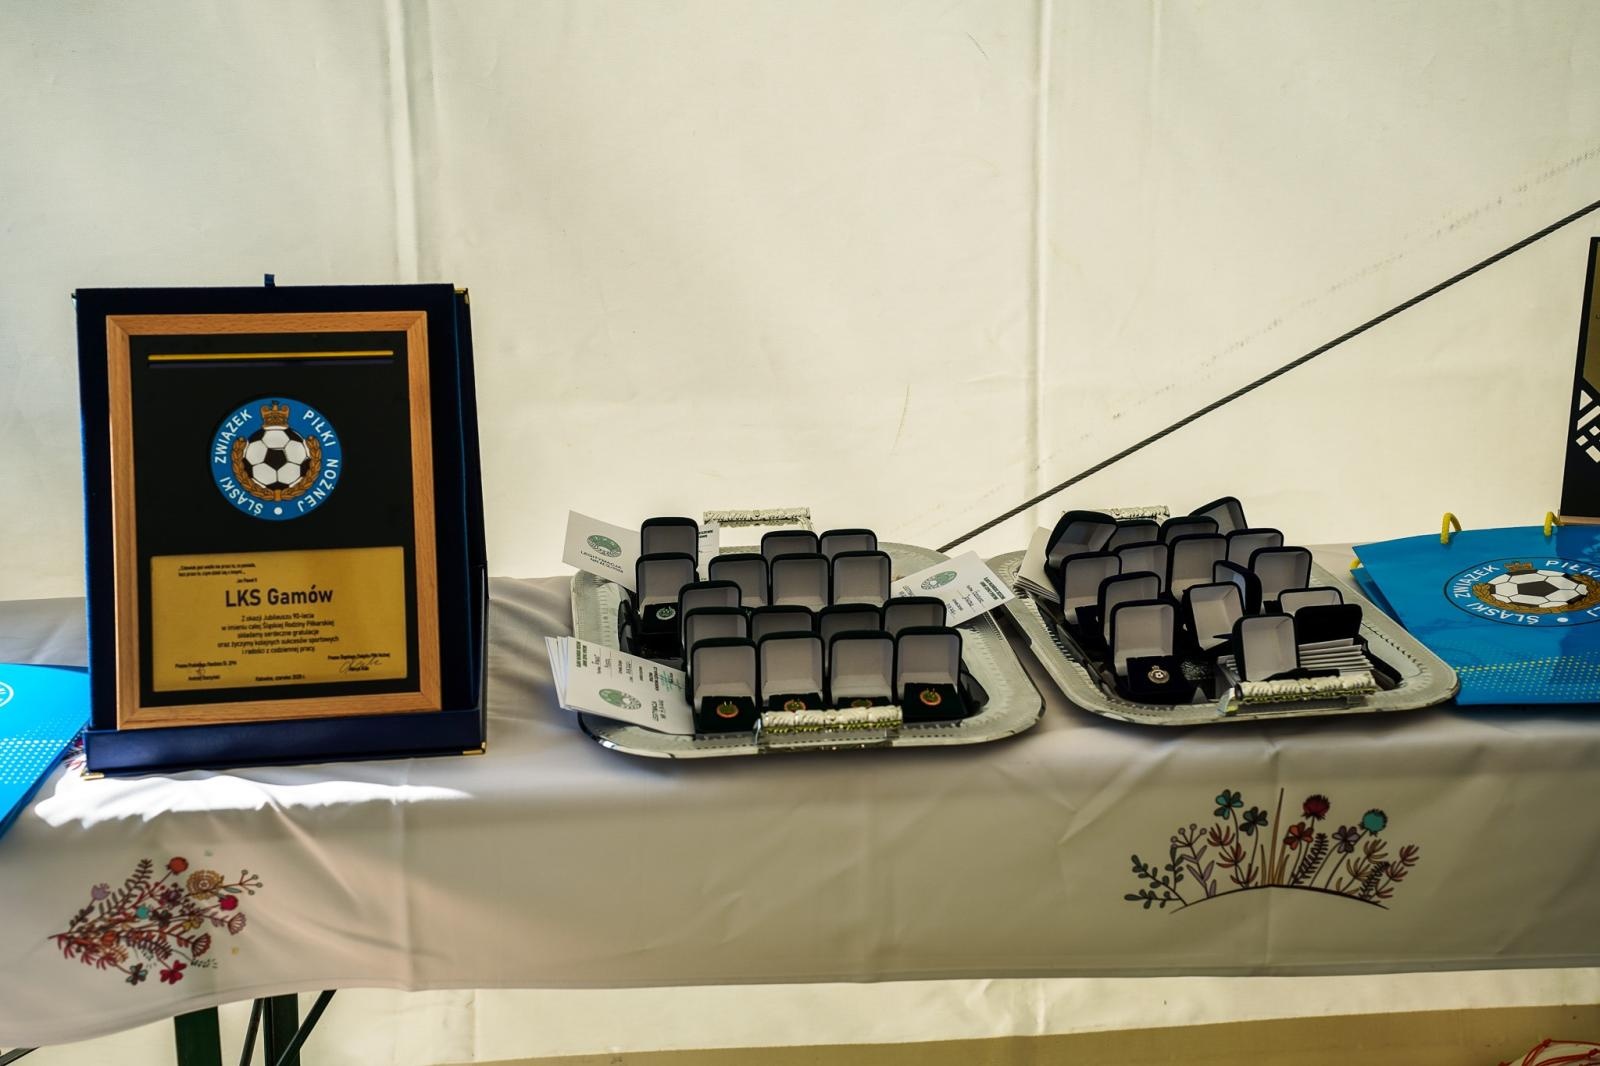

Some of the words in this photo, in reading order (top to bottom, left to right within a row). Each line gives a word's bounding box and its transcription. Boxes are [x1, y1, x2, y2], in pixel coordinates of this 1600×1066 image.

[215, 409, 252, 464] ZWIĄZEK
[303, 410, 337, 447] PIŁKI
[297, 458, 339, 512] NOŻNEJ
[225, 589, 261, 607] LKS
[267, 584, 333, 606] Gamów
[1453, 565, 1500, 598] ZWIĄZEK
